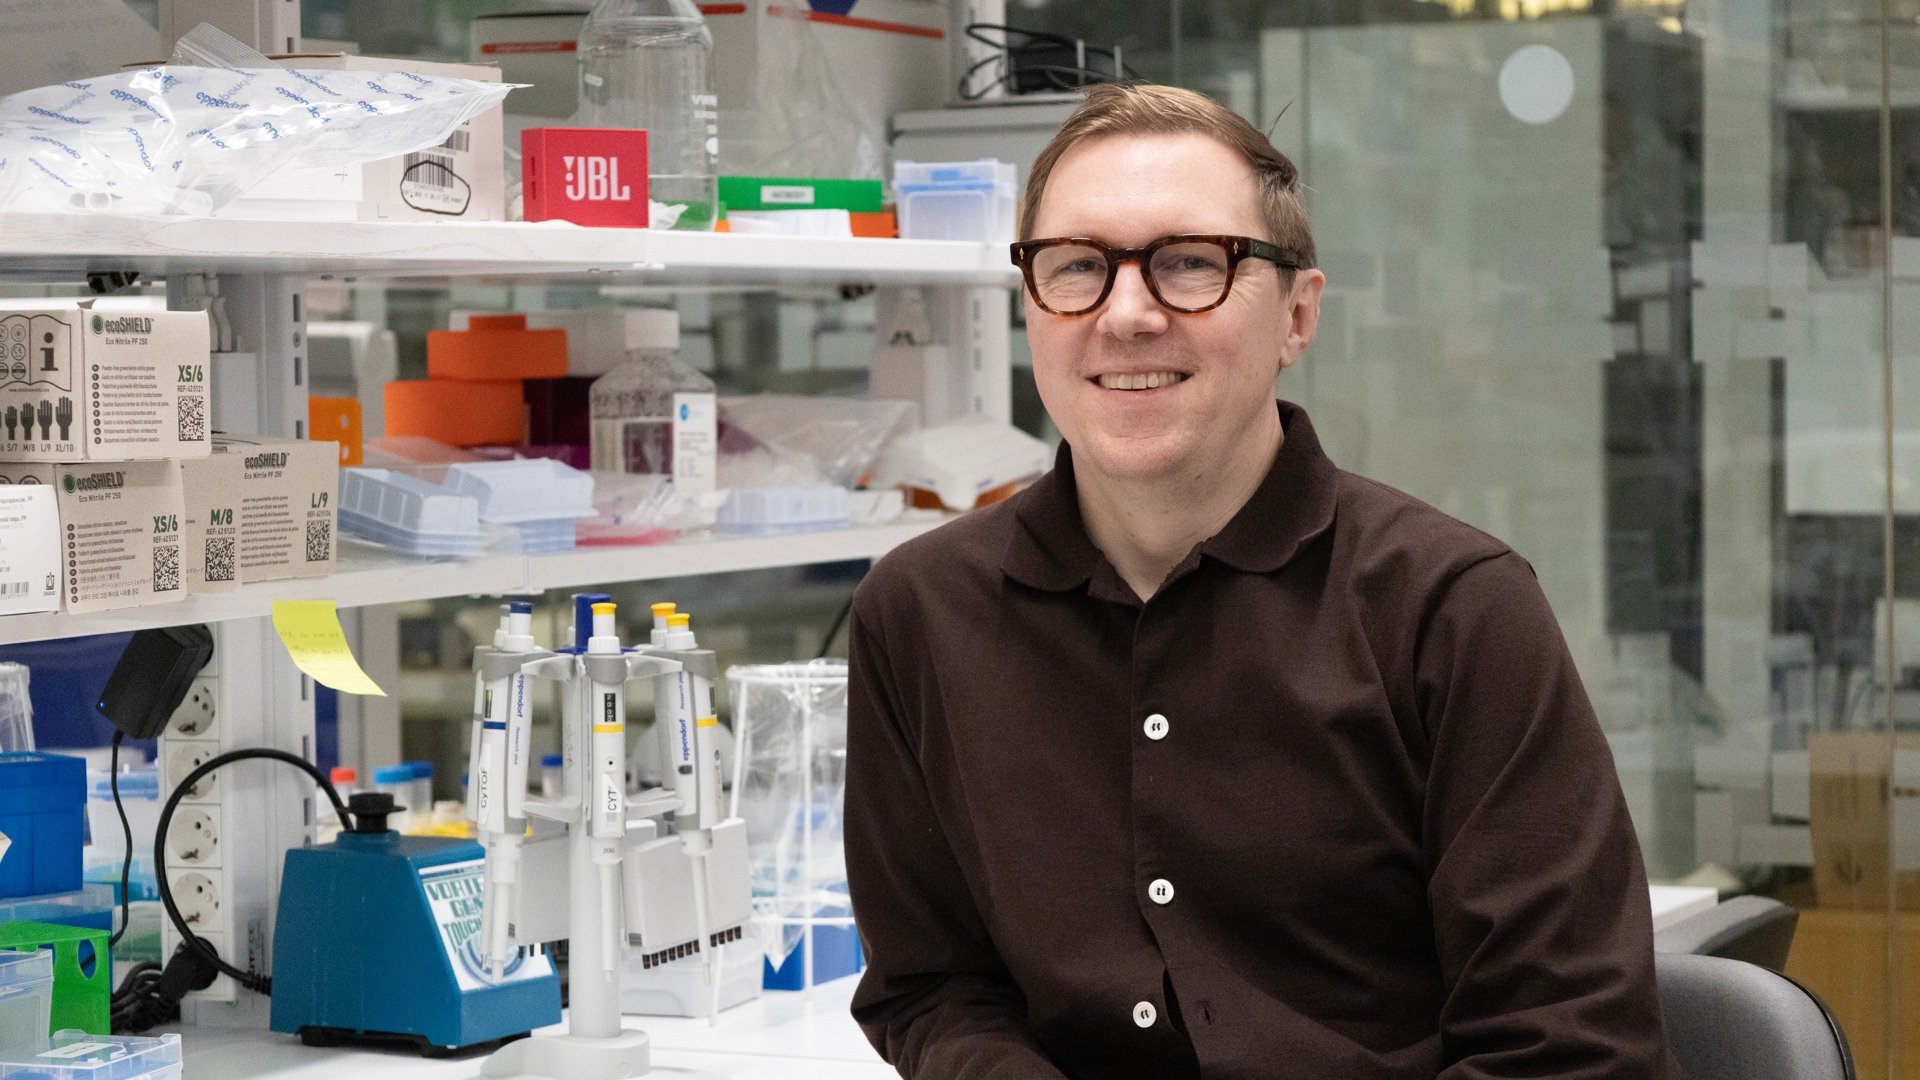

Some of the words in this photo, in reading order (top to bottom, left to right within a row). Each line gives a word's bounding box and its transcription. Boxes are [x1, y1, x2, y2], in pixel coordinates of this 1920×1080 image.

[27, 105, 92, 126] eppendorf
[563, 155, 631, 201] JBL
[105, 316, 152, 334] ecoSHIELD
[116, 337, 131, 345] Nitrile
[132, 337, 138, 345] PF
[139, 337, 148, 345] 250
[178, 365, 203, 382] XS/6
[56, 444, 74, 452] XL/10
[244, 452, 287, 469] ecoSHIELD
[77, 471, 124, 491] ecoSHIELD
[244, 472, 252, 480] Eco
[78, 495, 88, 503] Eco
[89, 493, 104, 502] Nitrile
[112, 492, 121, 500] 250
[311, 492, 329, 508] L/9
[153, 514, 179, 534] XS/6
[210, 509, 233, 526] M/8
[516, 674, 525, 718] eppendorf
[679, 719, 690, 761] eppendorf
[607, 786, 617, 811] CYT
[426, 876, 485, 901] VORTE
